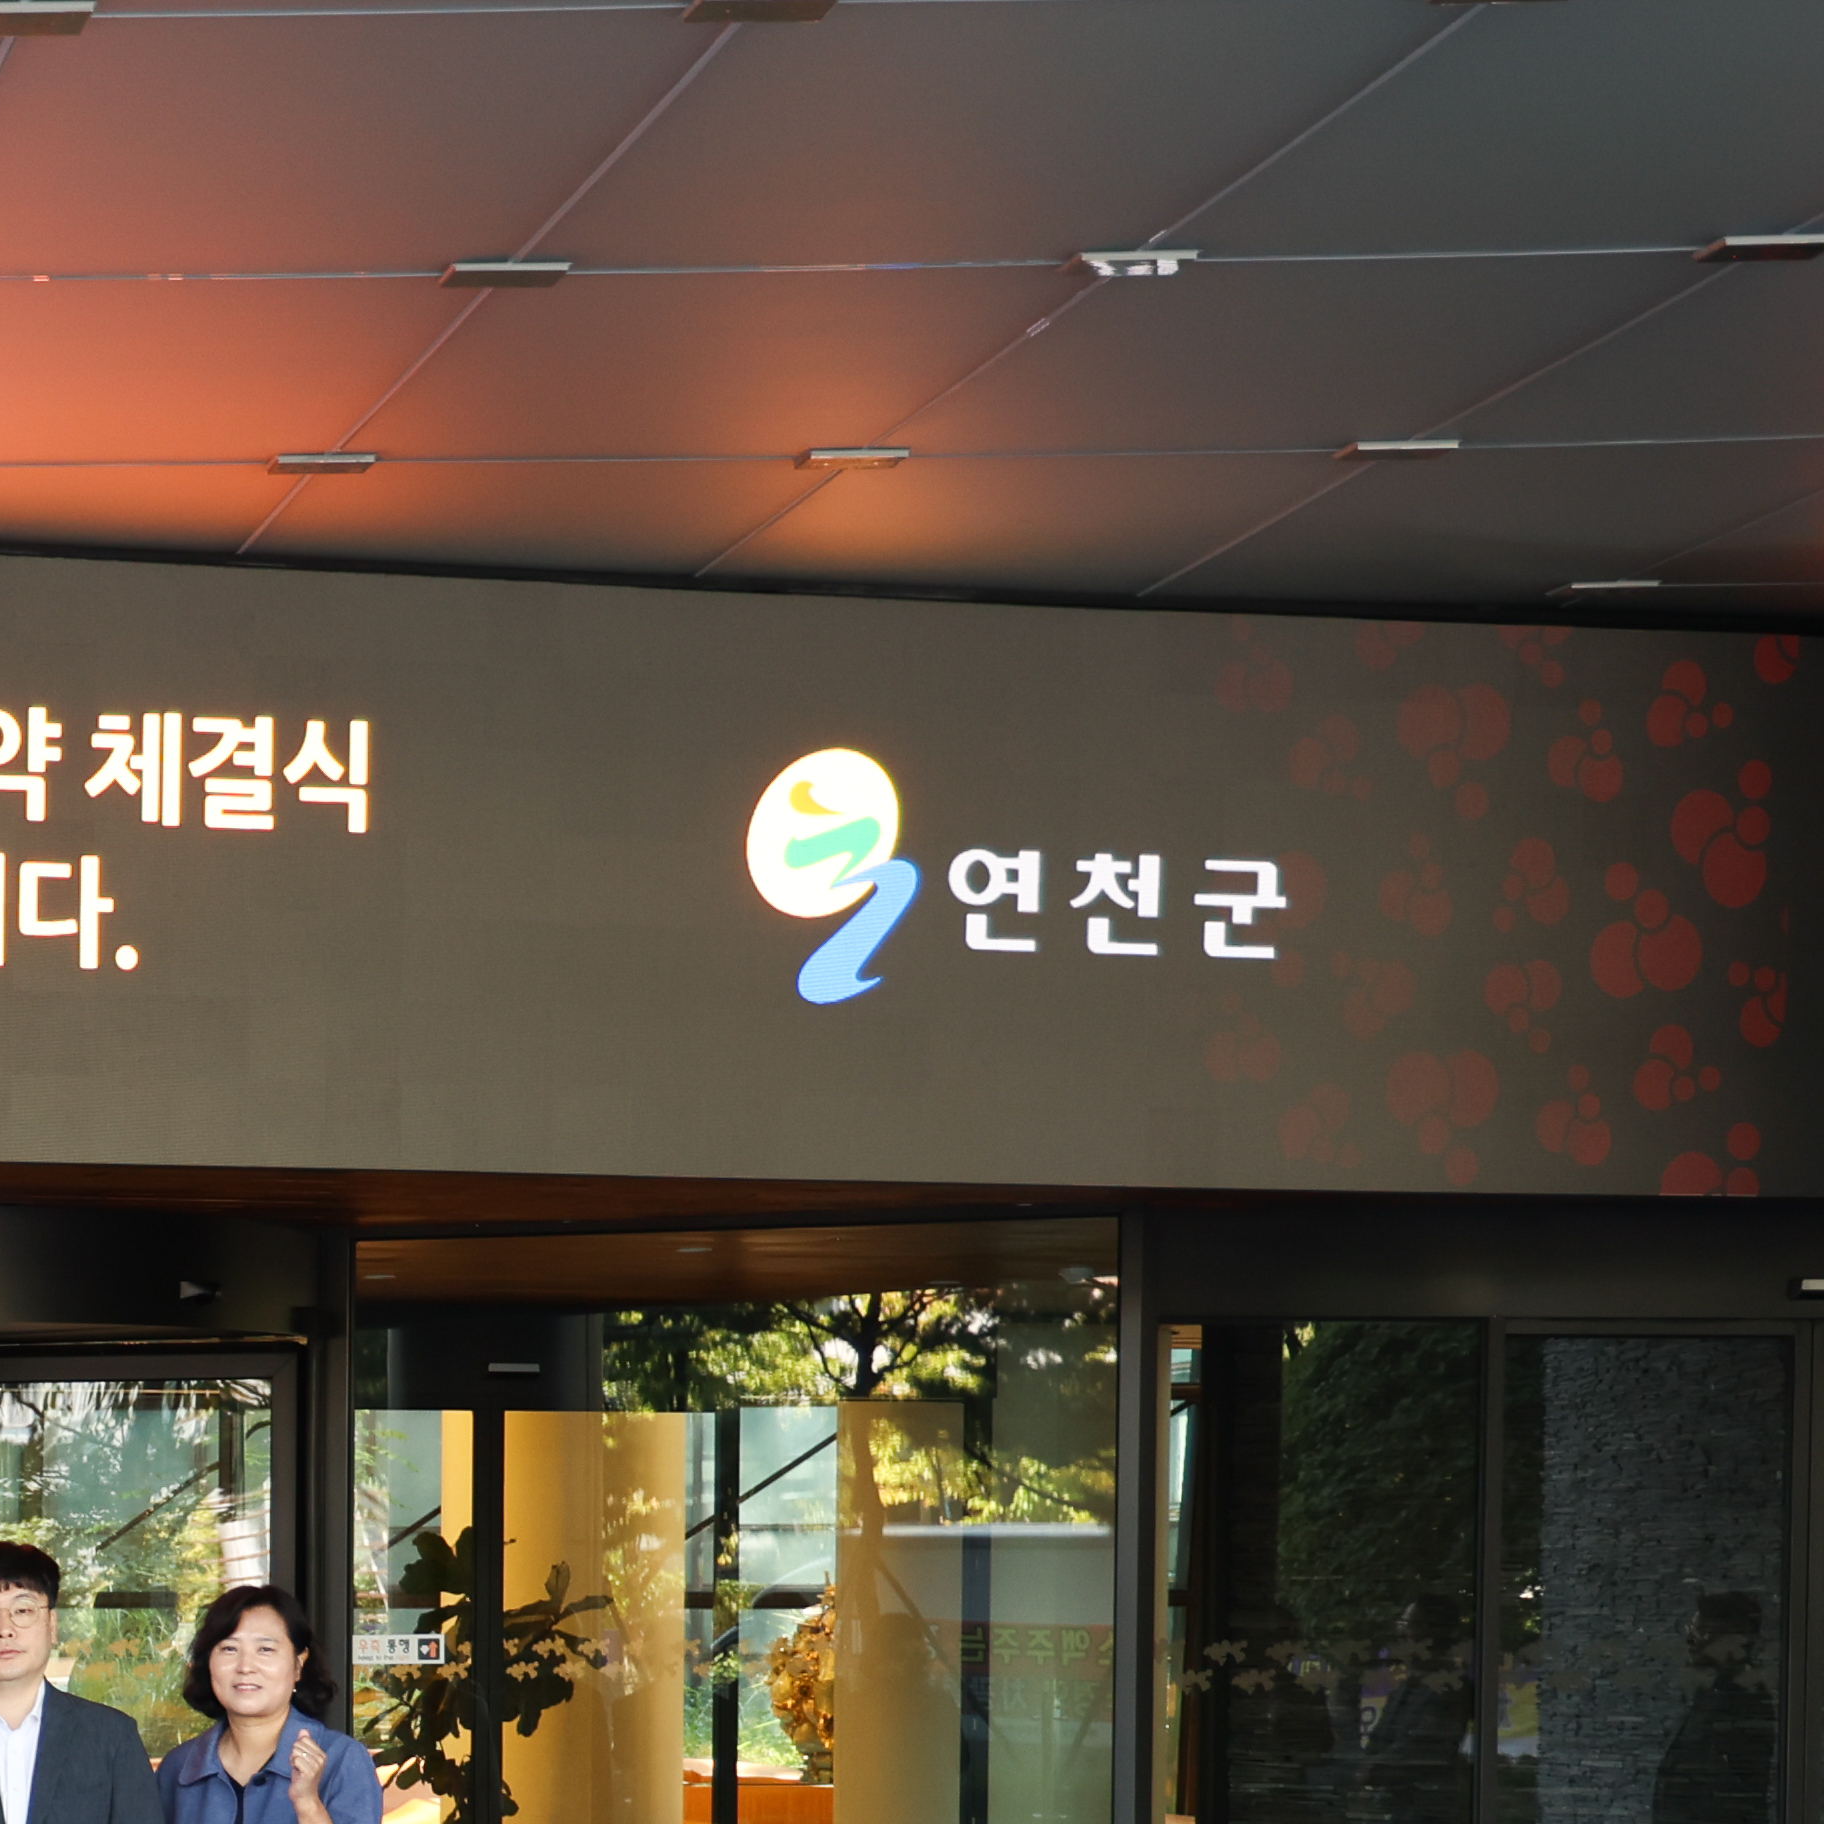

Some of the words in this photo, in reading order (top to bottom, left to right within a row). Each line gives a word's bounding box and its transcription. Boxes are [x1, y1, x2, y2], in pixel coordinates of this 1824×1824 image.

[85, 712, 368, 833] 체결식
[949, 849, 1286, 958] 연천군
[387, 1639, 410, 1654] 통행
